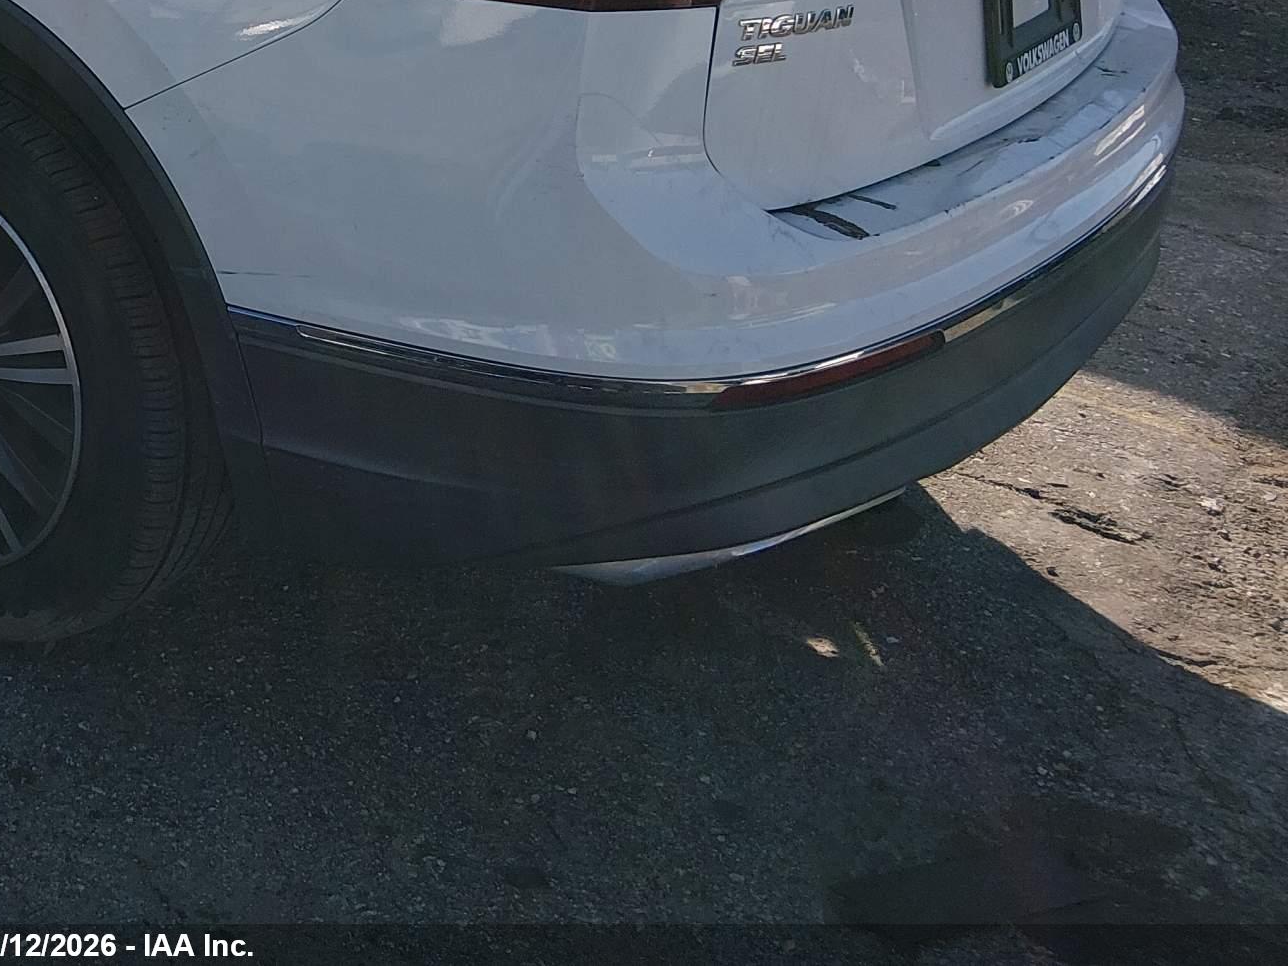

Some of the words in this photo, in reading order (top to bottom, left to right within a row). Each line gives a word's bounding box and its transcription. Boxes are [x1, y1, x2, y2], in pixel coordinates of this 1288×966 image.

[739, 5, 855, 41] TIGUAN
[732, 42, 786, 67] SEL
[1016, 28, 1070, 76] VOLKSWAGEN
